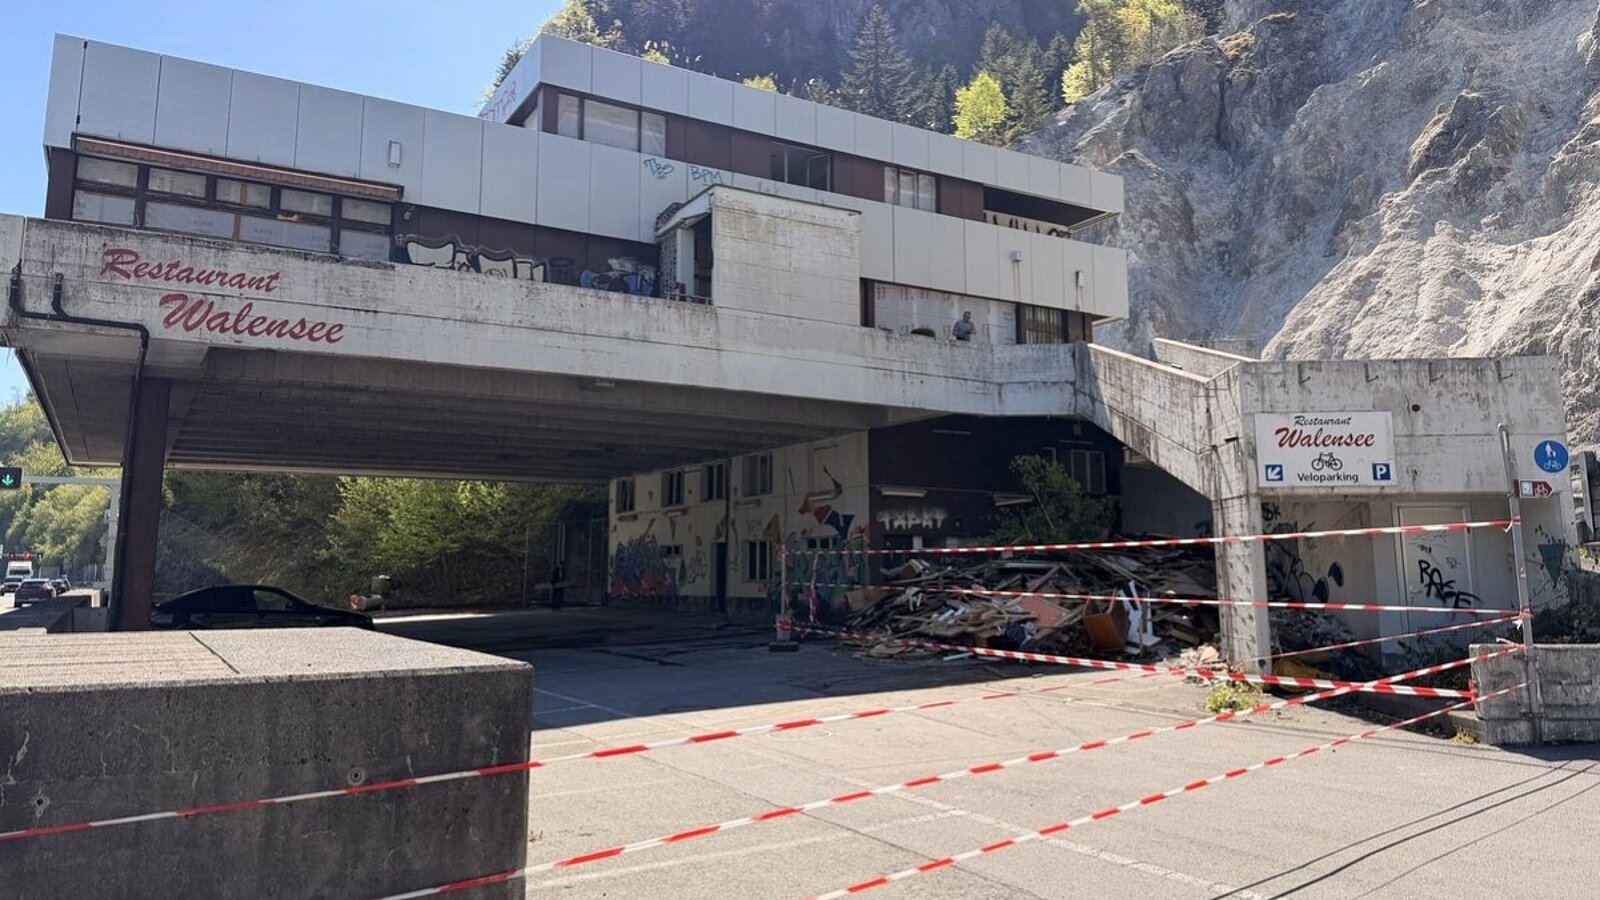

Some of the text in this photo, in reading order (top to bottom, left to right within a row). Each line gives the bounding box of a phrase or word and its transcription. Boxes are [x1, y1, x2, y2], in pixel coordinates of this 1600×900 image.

[101, 248, 281, 293] Restaurant
[159, 293, 345, 344] Walensee
[1294, 415, 1351, 426] Restaurant
[1275, 427, 1375, 448] Walensee
[1297, 472, 1359, 483] Veloparking
